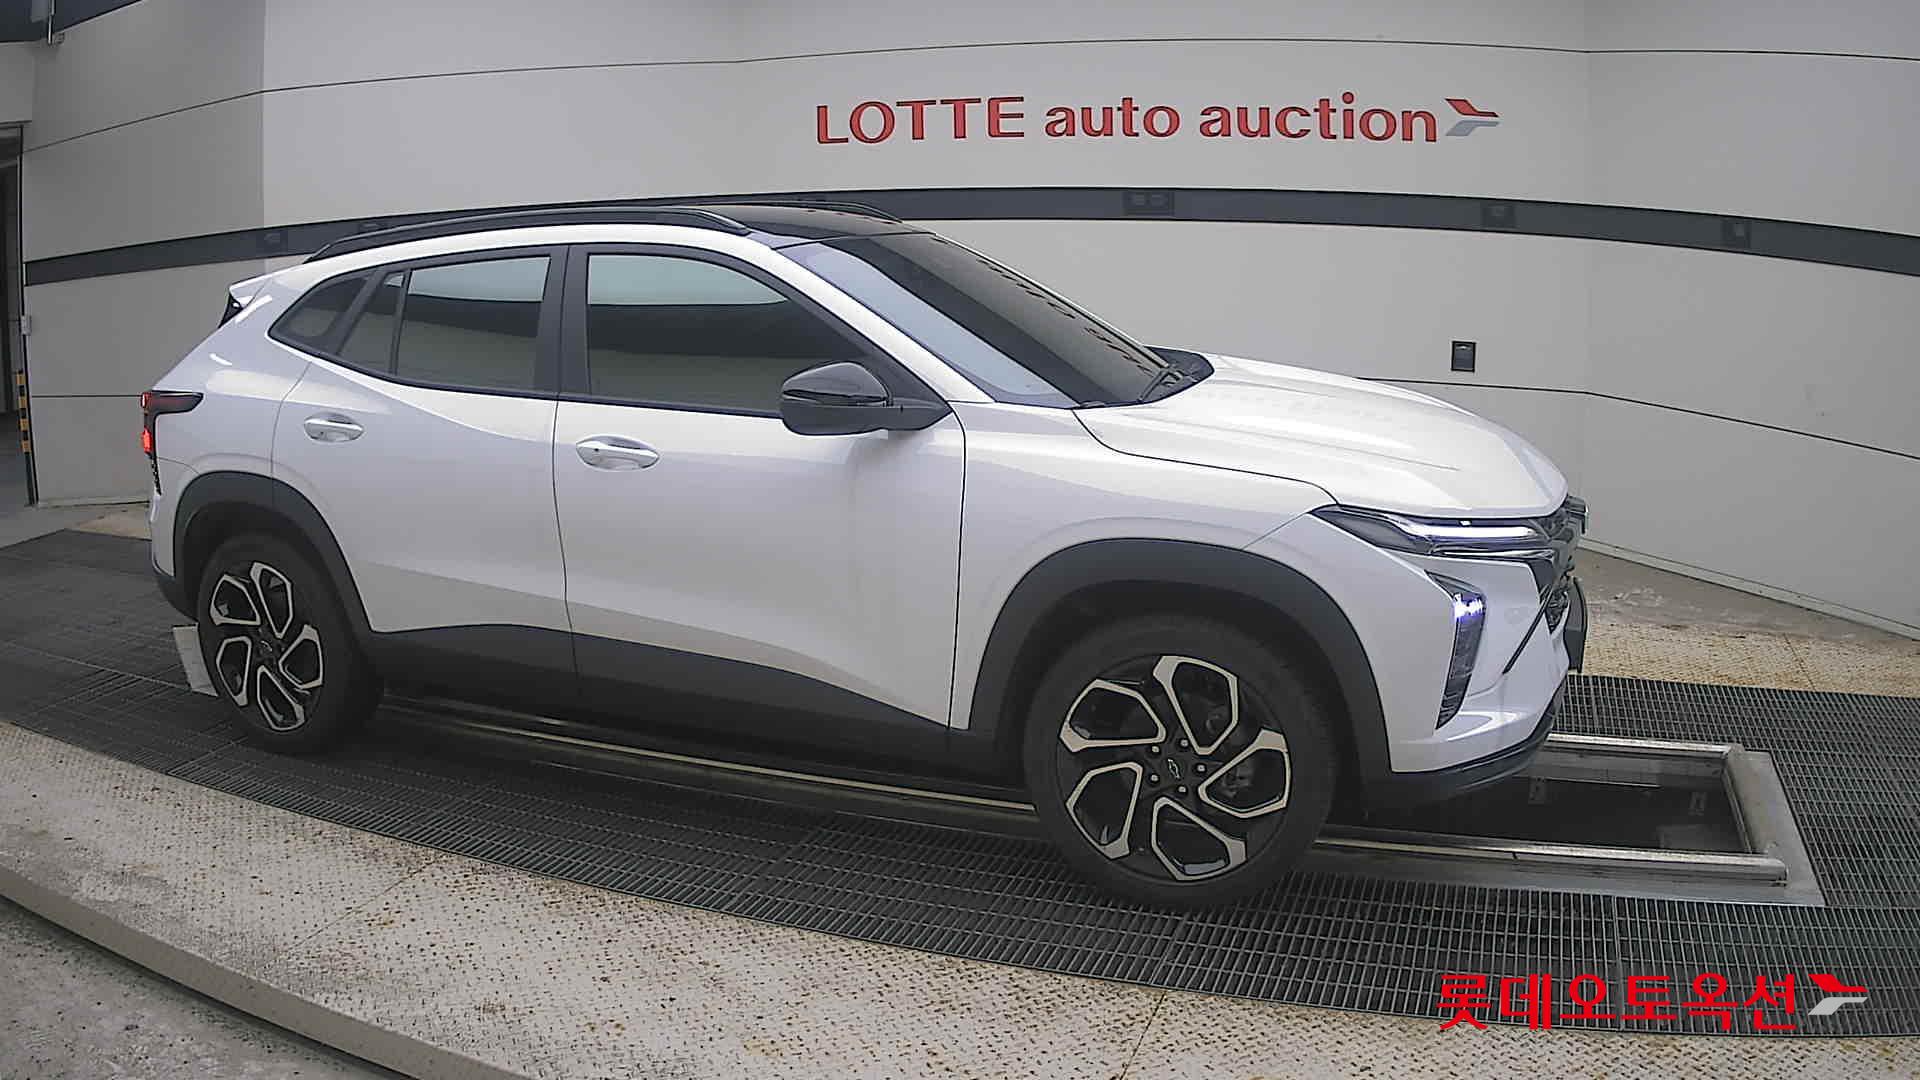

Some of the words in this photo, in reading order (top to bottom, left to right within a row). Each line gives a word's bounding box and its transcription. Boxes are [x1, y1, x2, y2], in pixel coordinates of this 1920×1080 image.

[816, 95, 1025, 144] LOTTE
[1044, 97, 1181, 138] auto
[1199, 92, 1438, 142] auction
